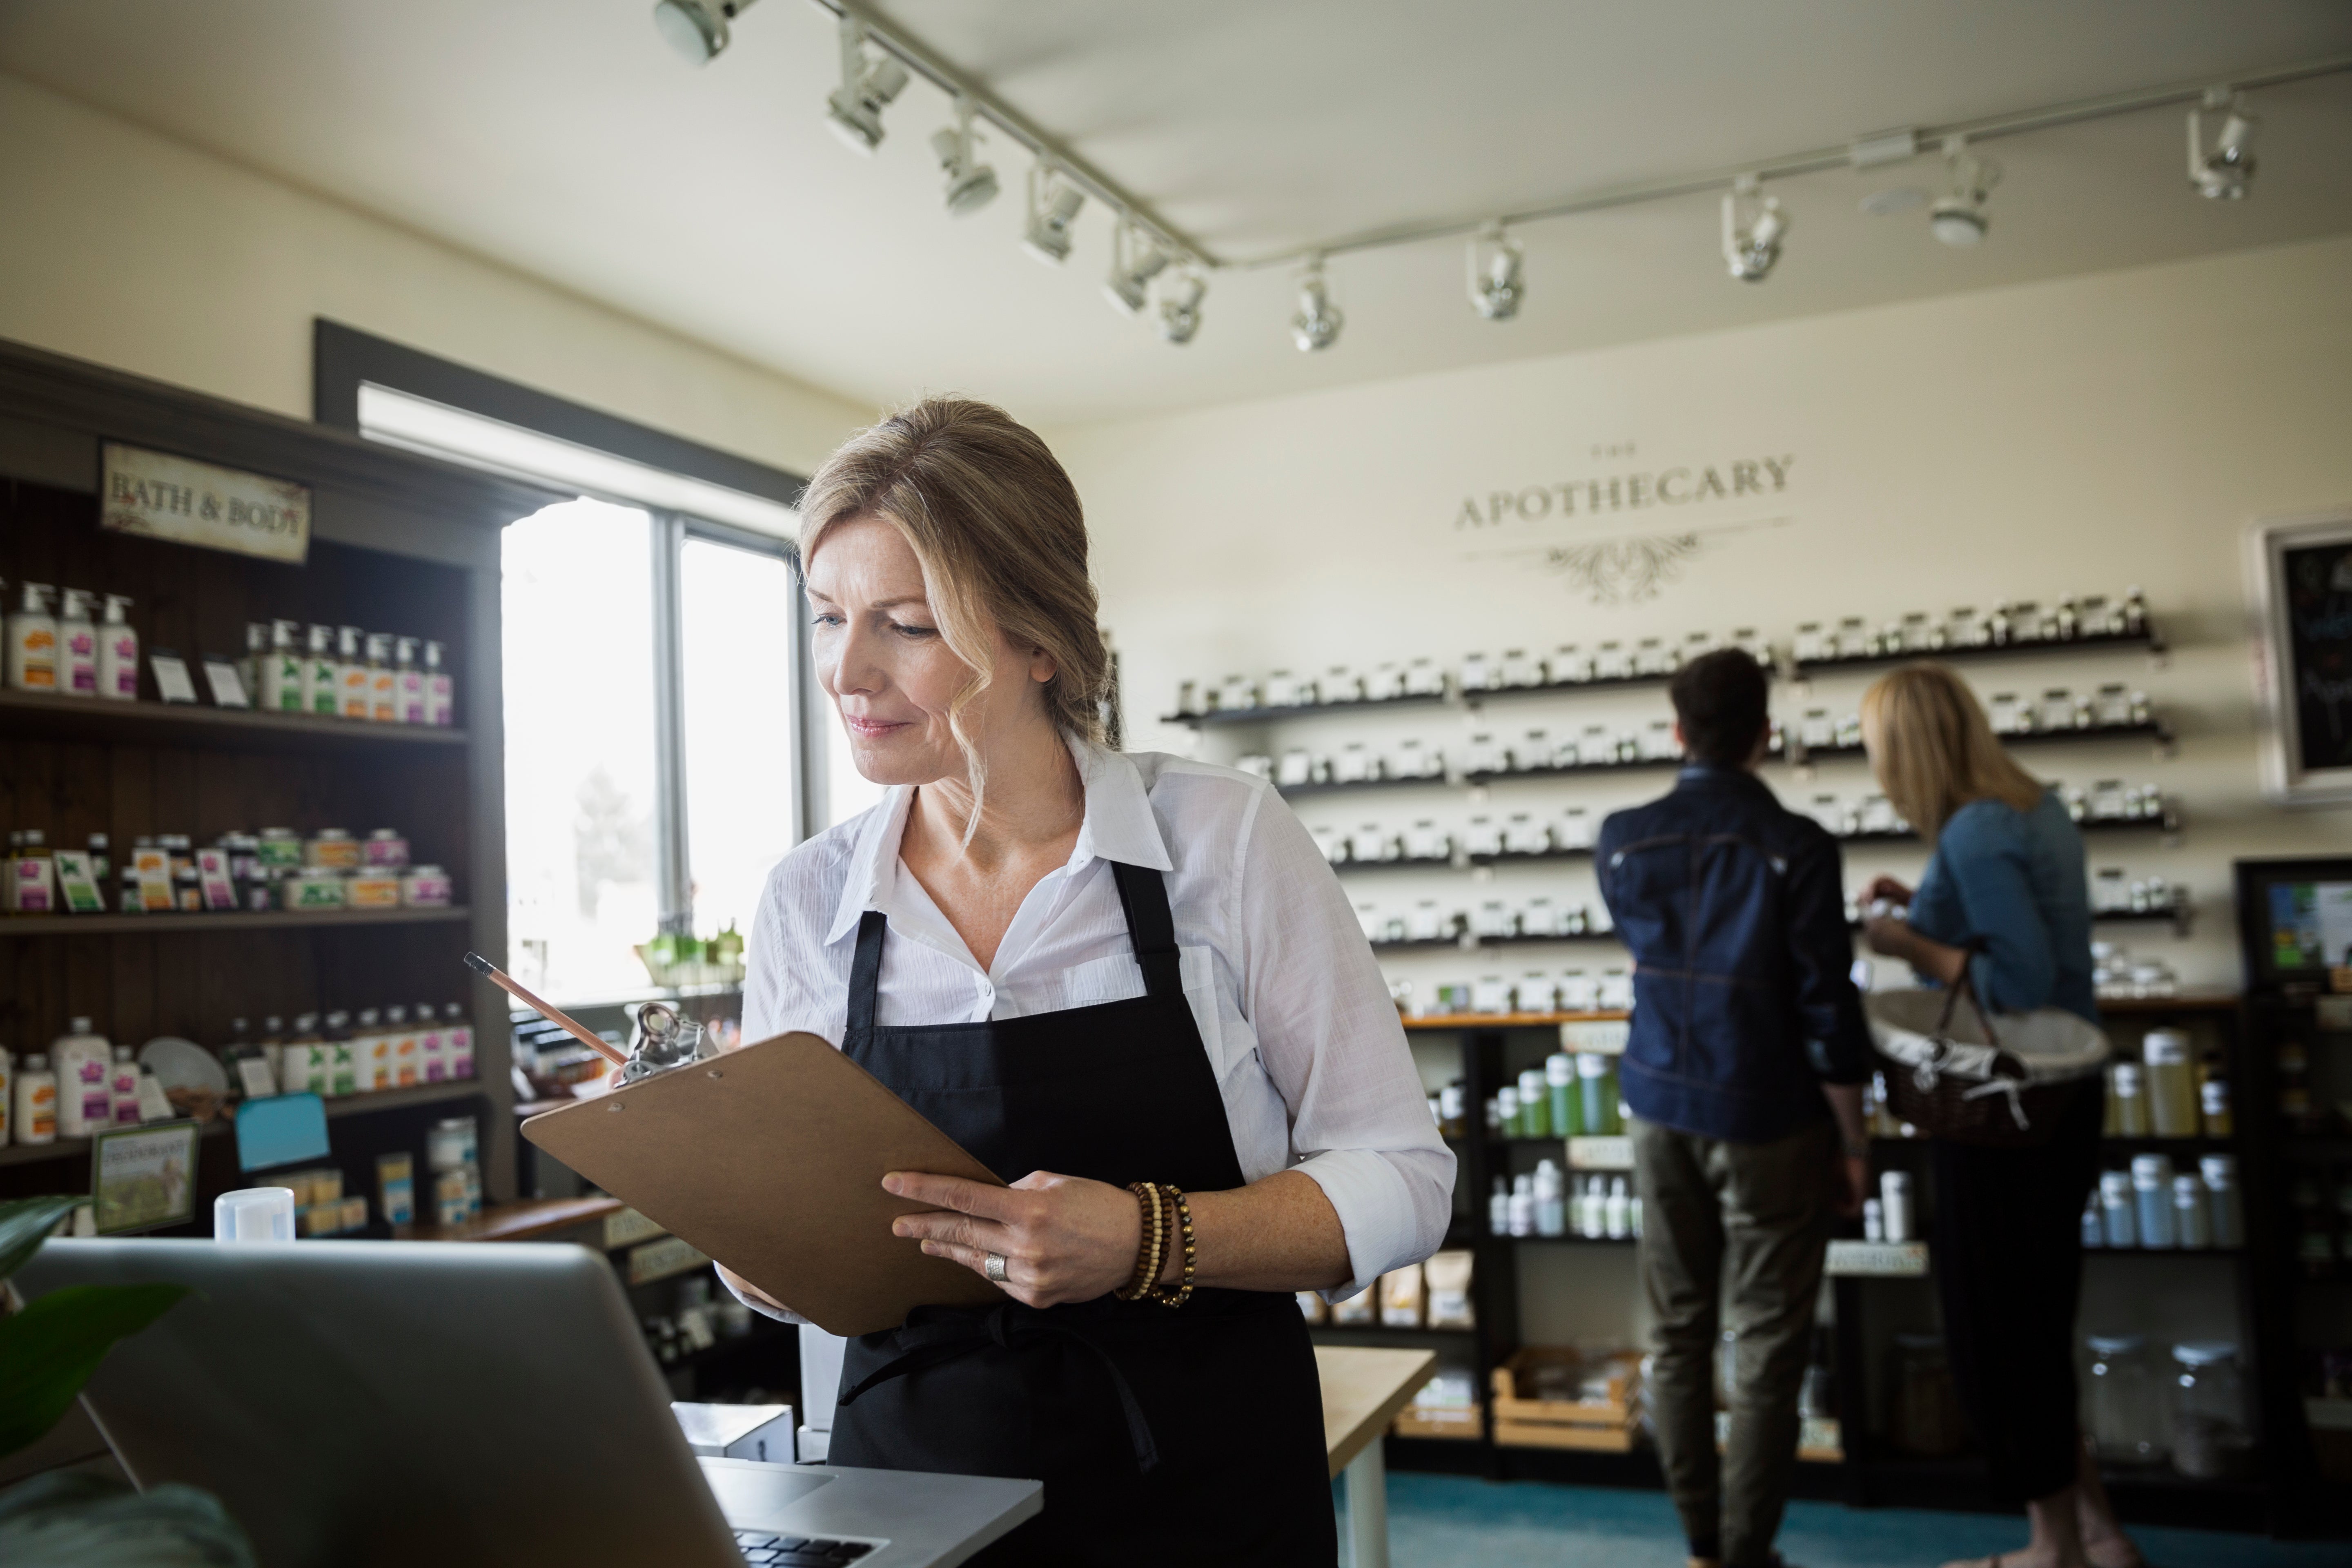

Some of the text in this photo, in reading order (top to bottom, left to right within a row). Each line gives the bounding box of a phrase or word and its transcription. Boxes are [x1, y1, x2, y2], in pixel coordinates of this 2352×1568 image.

[111, 472, 303, 538] BATH & BODY
[1454, 453, 1794, 530] APOTHECARY
